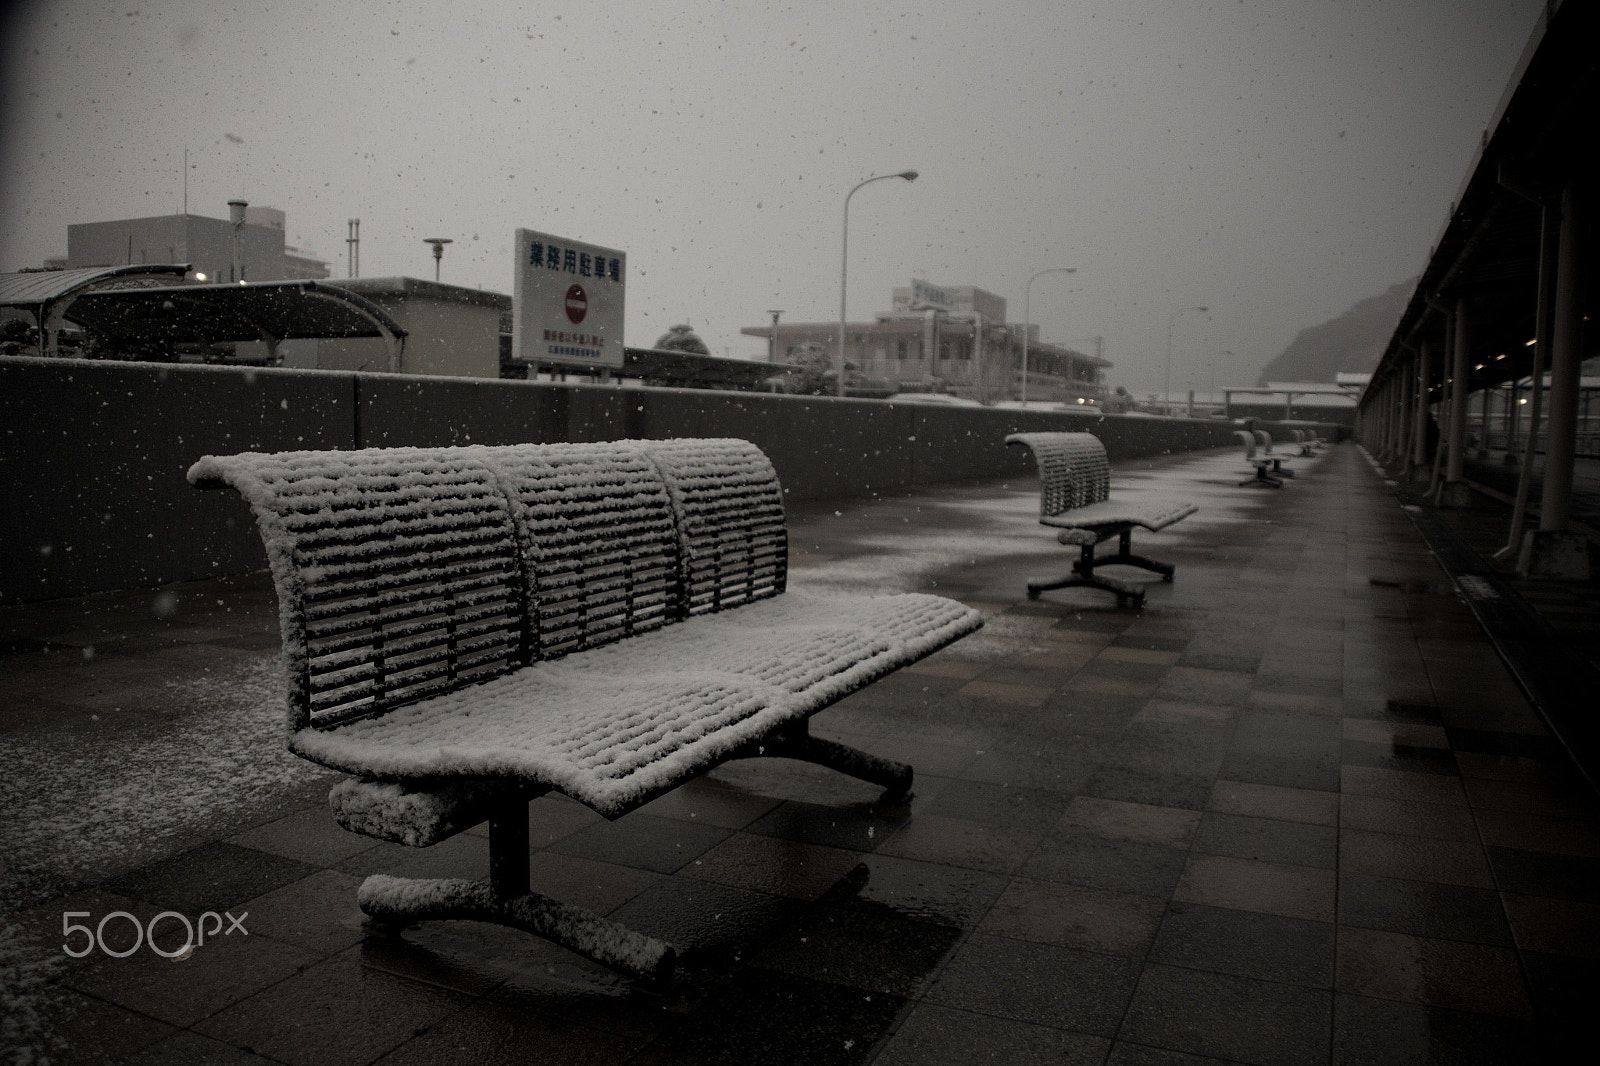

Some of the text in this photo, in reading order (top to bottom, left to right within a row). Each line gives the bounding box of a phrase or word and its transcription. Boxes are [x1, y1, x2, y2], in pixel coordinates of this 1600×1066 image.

[530, 241, 620, 282] 業務用駐車場
